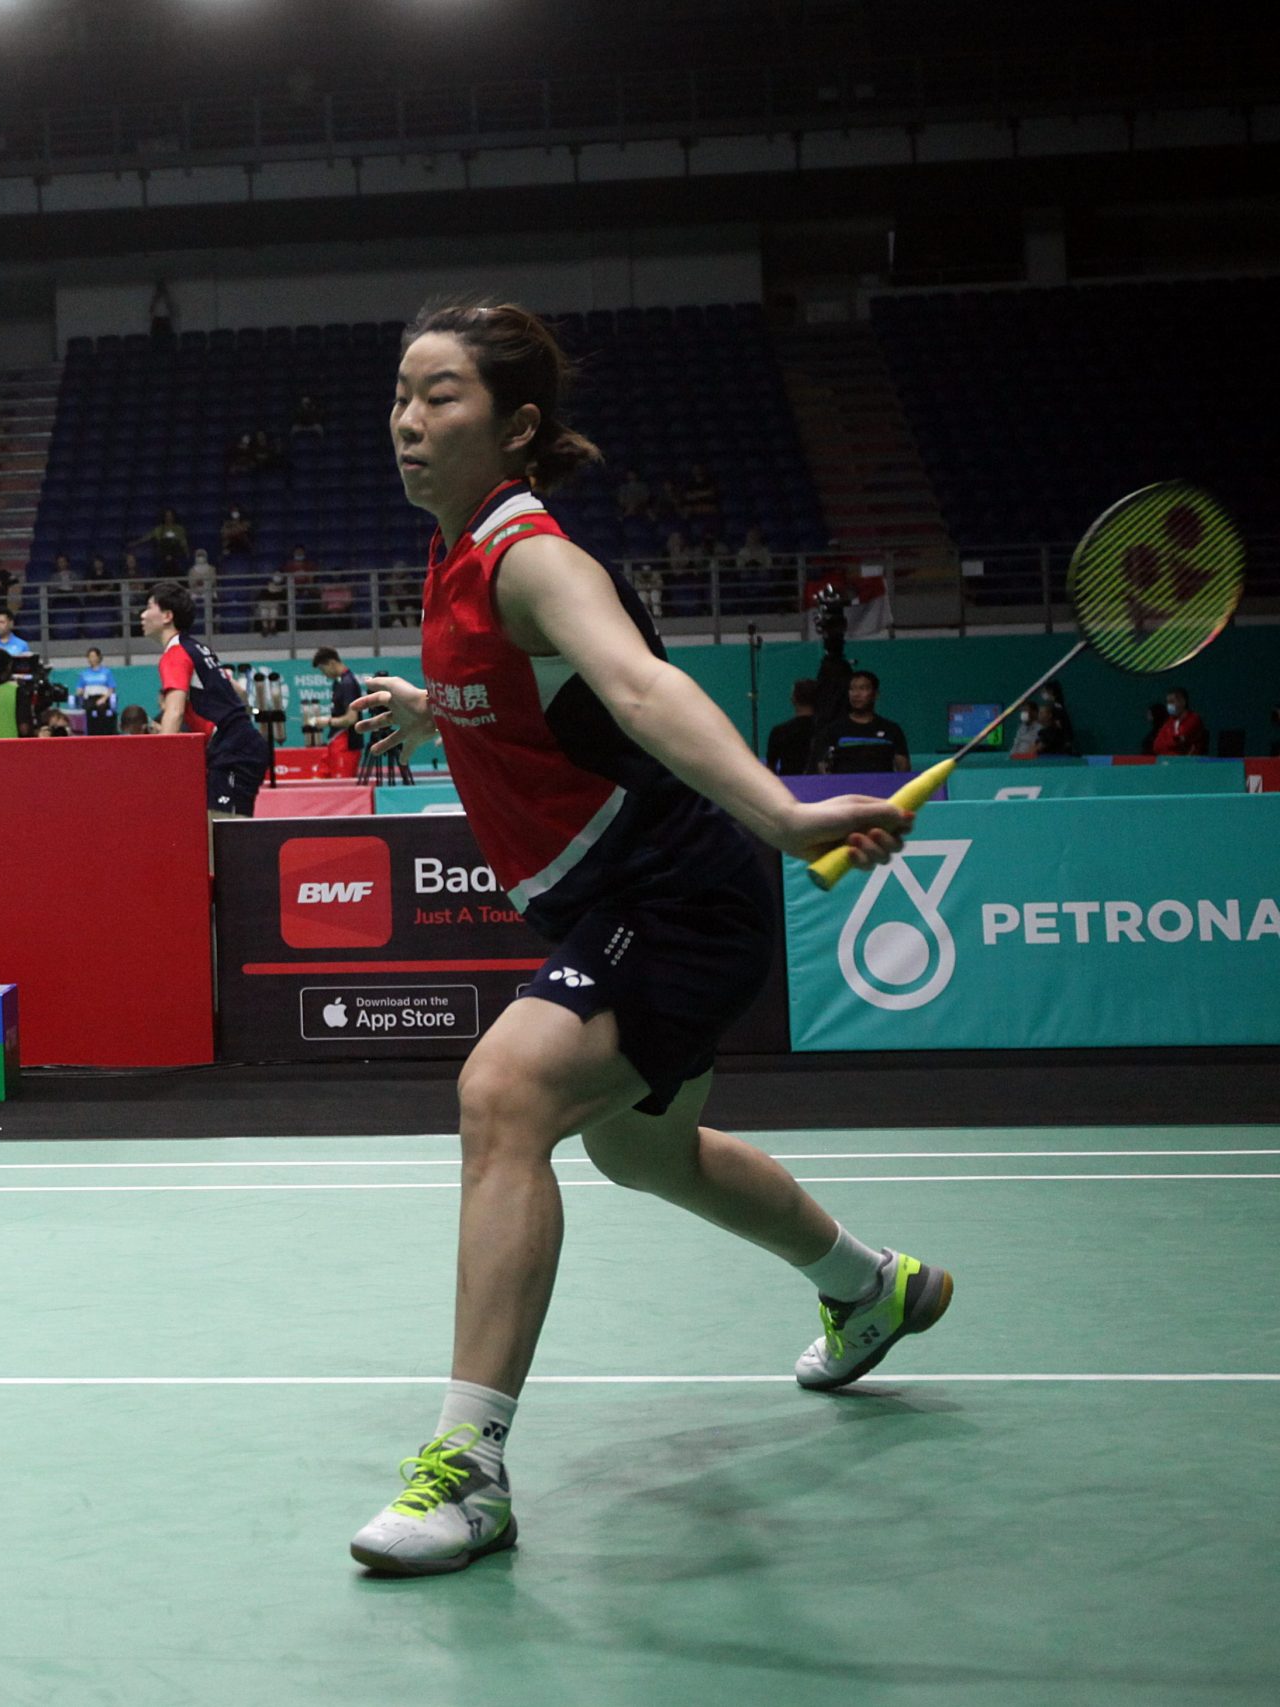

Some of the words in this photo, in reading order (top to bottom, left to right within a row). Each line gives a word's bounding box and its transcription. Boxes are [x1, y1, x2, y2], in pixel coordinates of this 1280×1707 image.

[414, 857, 504, 894] Bad
[297, 881, 373, 904] BWF
[414, 908, 452, 925] Just
[457, 907, 473, 923] A
[477, 905, 525, 923] Touc
[981, 899, 1280, 945] PETRONA
[356, 997, 410, 1007] Download
[413, 998, 426, 1007] on
[429, 996, 449, 1007] the
[356, 1009, 397, 1031] App
[401, 1008, 456, 1027] Store
